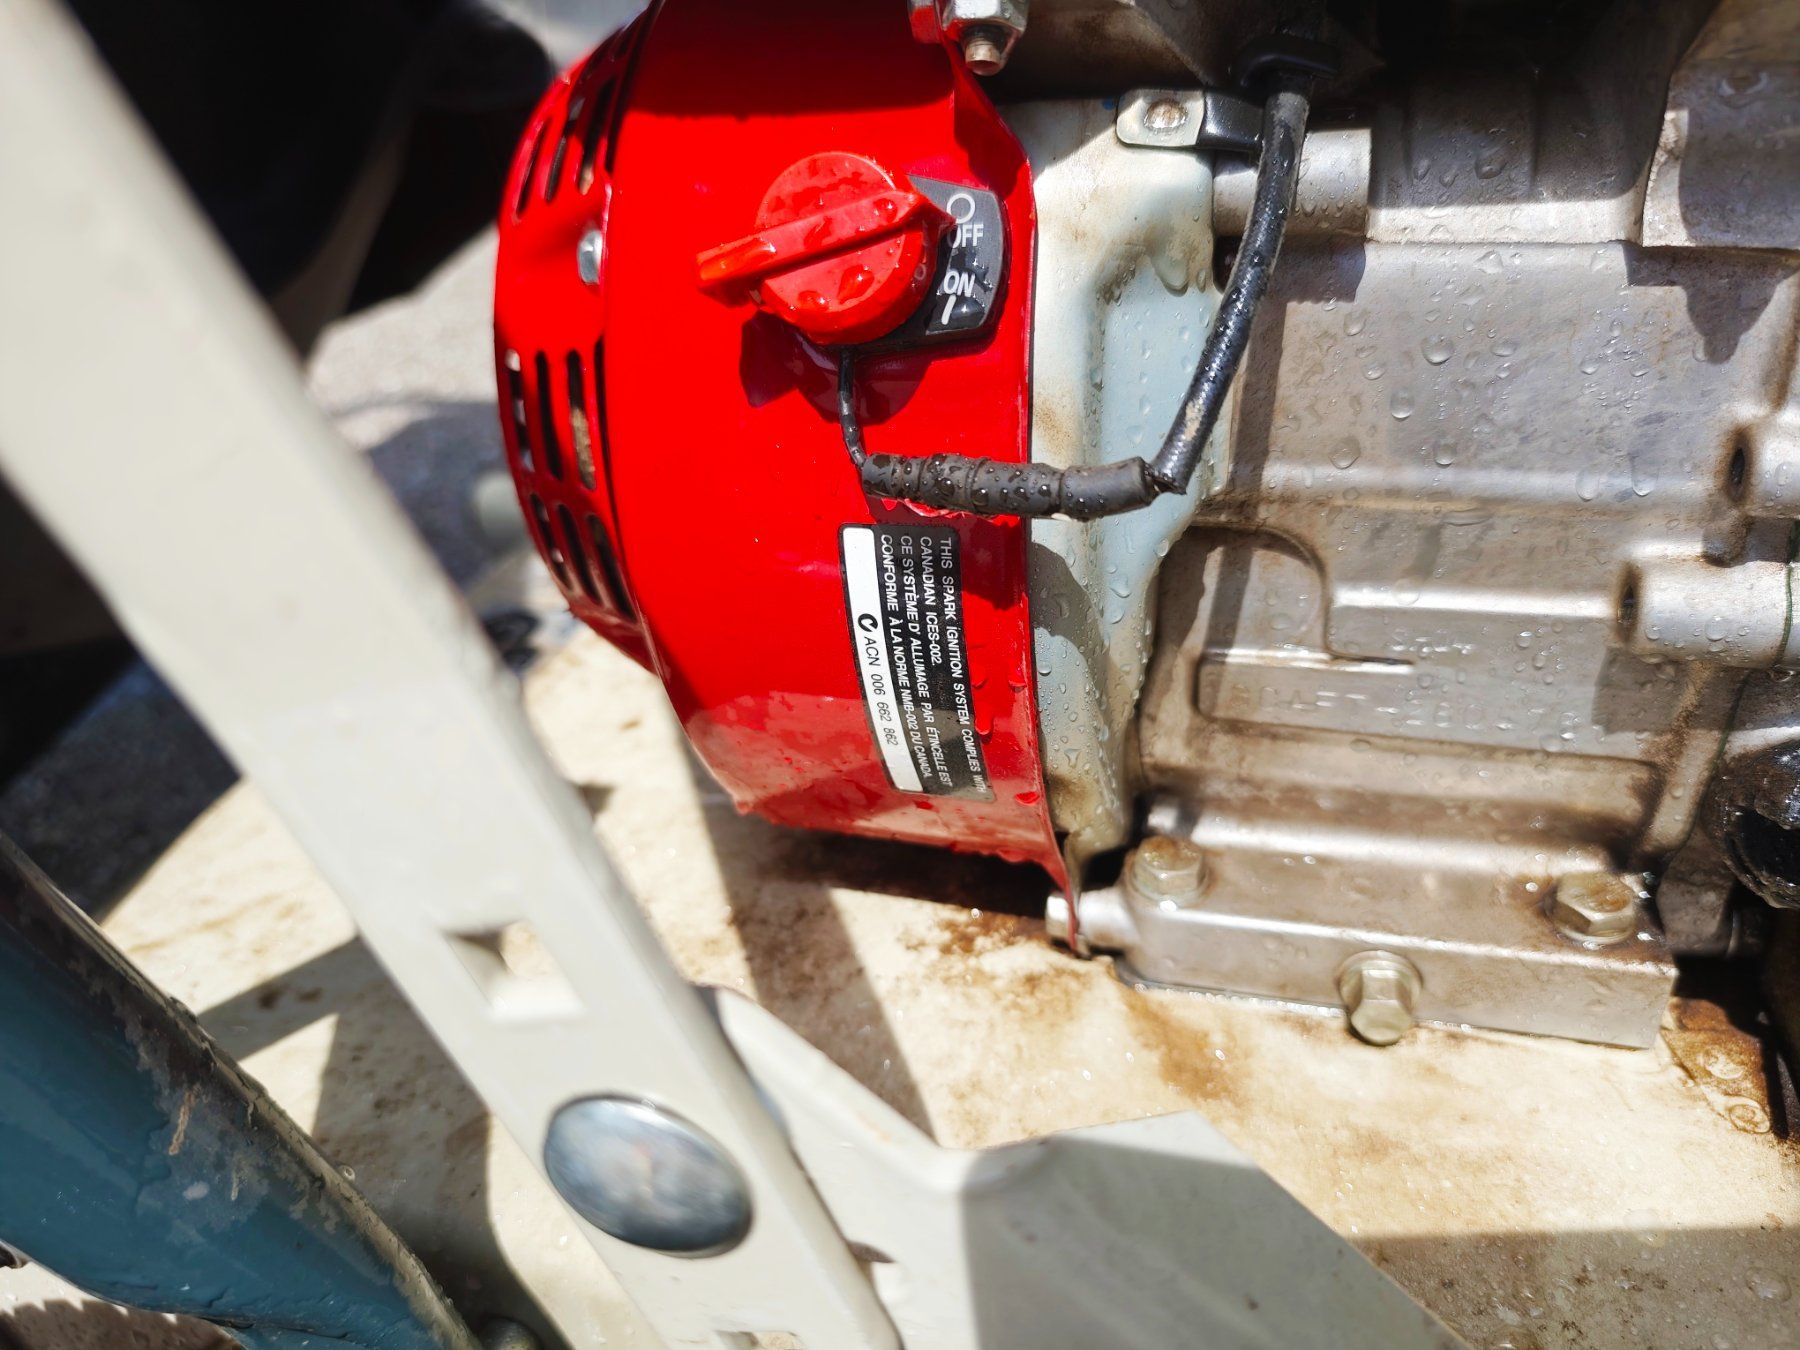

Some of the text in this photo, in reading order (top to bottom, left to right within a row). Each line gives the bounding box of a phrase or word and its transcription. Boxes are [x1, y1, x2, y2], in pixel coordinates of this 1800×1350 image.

[947, 223, 984, 249] OFF
[943, 270, 976, 298] ON
[900, 535, 913, 555] CE
[881, 534, 899, 612] CONFORME
[902, 558, 919, 621] SYSTÈME
[920, 536, 936, 606] CANADIAN
[889, 628, 903, 644] LA
[893, 645, 911, 688] NORME
[910, 637, 930, 698] ALLUMAGE
[940, 537, 987, 793] THIS SPARK IGNITION SYSTEM COMPLIES WITH
[864, 636, 899, 746] ACN 006 662 862
[901, 688, 919, 730] NMB-002
[921, 702, 935, 723] PAR
[910, 732, 923, 745] DU
[925, 727, 948, 772] ÉTINCELLE
[938, 771, 953, 787] EST
